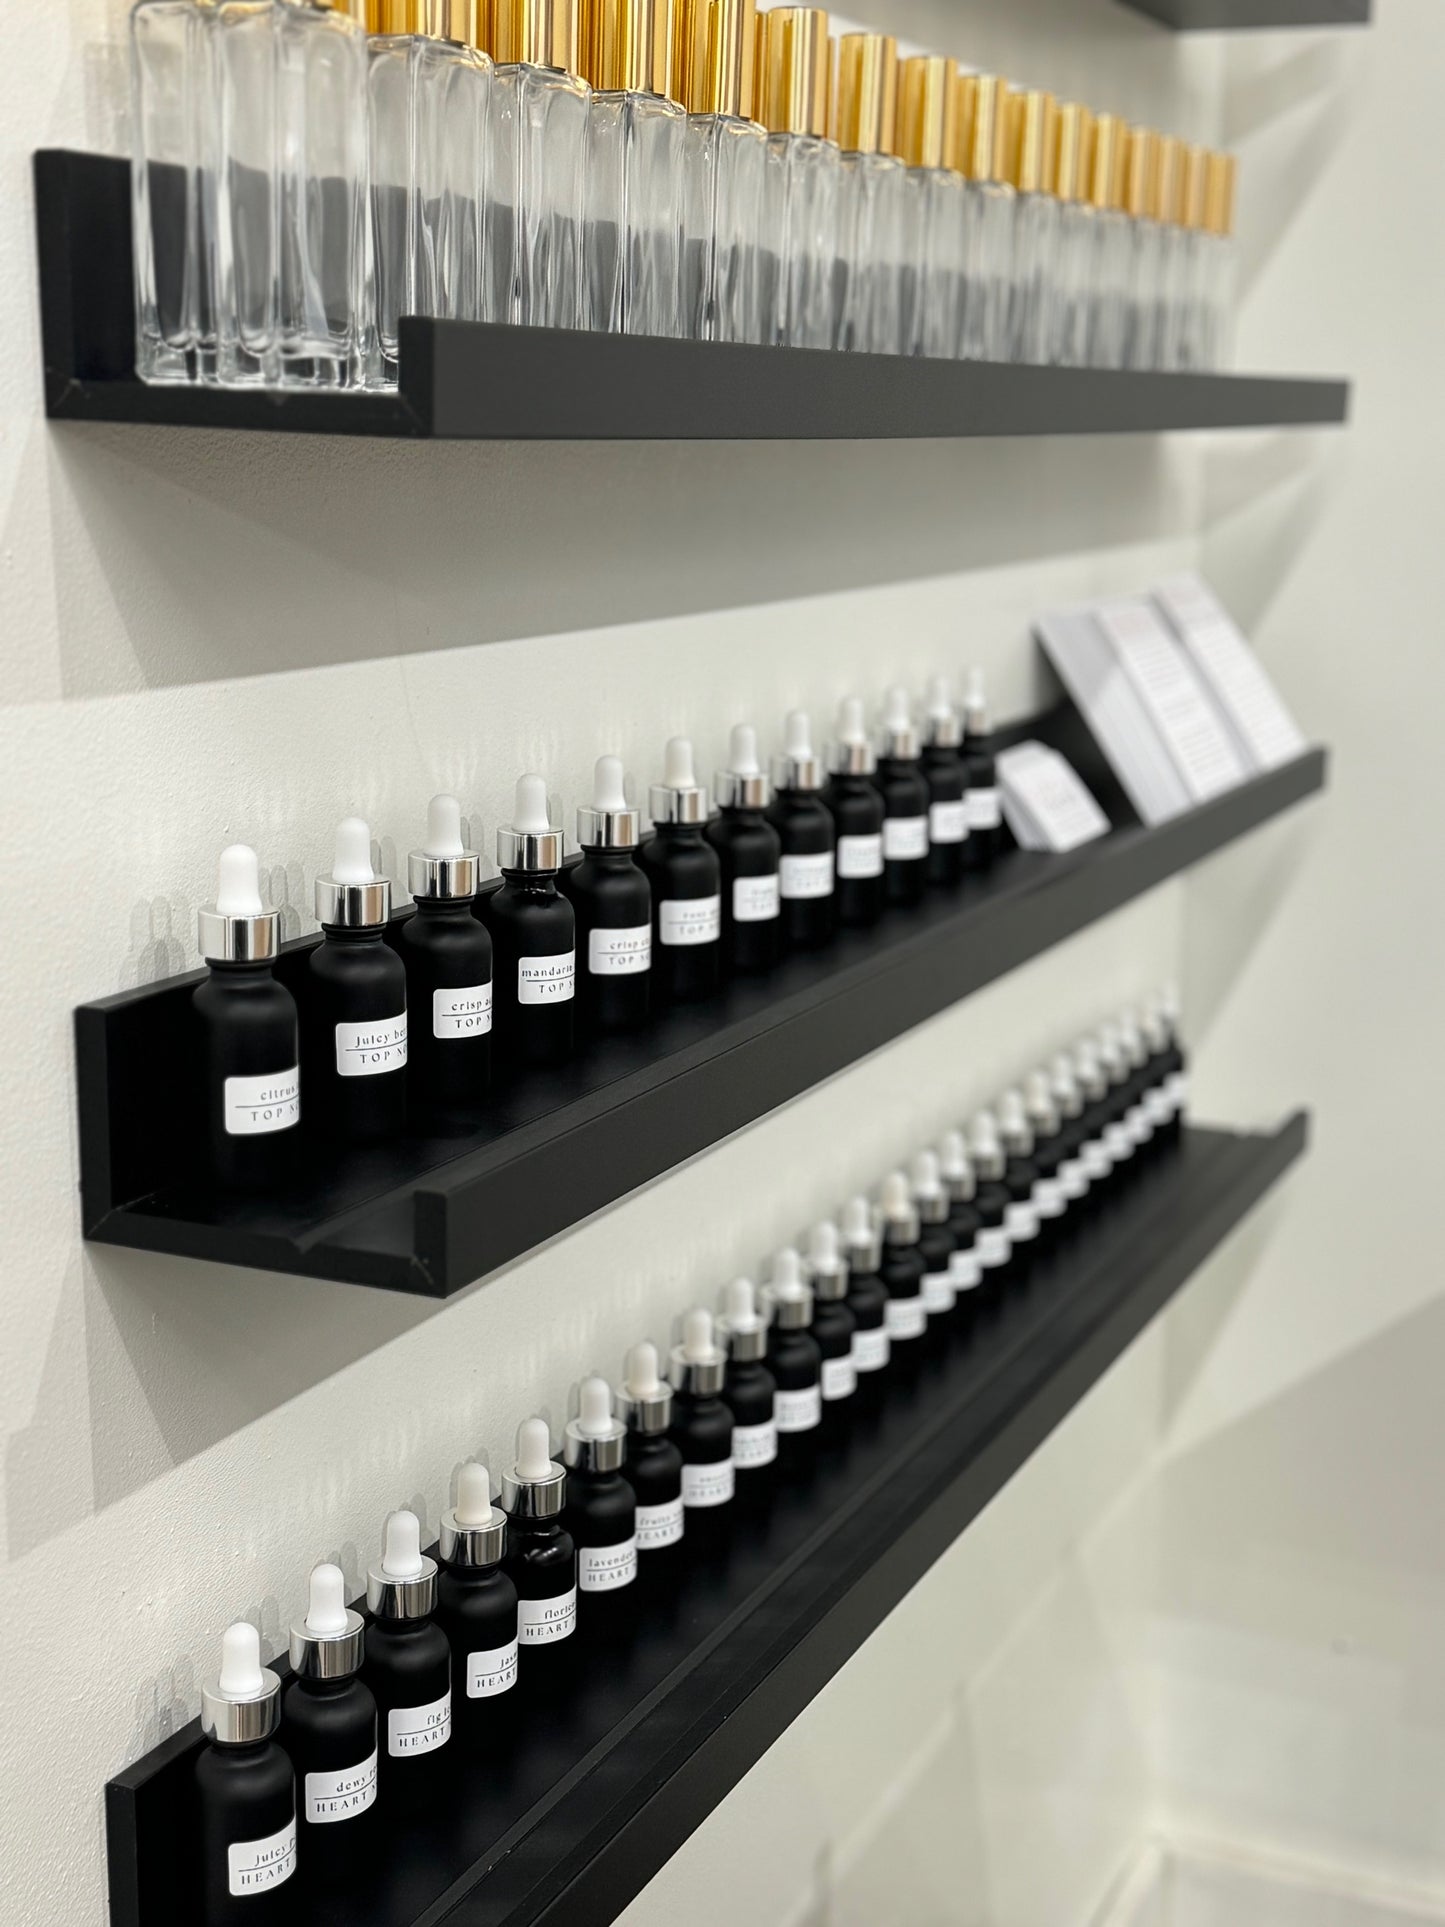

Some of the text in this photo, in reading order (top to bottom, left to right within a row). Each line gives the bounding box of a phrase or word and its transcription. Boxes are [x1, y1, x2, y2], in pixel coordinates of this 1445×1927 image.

[609, 956, 634, 966] TOP
[539, 982, 564, 994] TOP
[451, 1000, 482, 1011] crisp
[455, 1016, 482, 1029] TOP
[360, 1050, 391, 1064] TOP
[260, 1086, 296, 1101] citrus
[250, 1107, 283, 1122] TOP
[588, 1566, 630, 1583] HEART
[525, 1620, 569, 1637] HEART
[477, 1667, 516, 1688] HEART
[426, 1712, 442, 1726] fig
[399, 1726, 445, 1748] HEART
[336, 1775, 367, 1793] dewy
[316, 1791, 368, 1813] HEART
[254, 1843, 288, 1868] juicy
[241, 1857, 291, 1886] HEART
